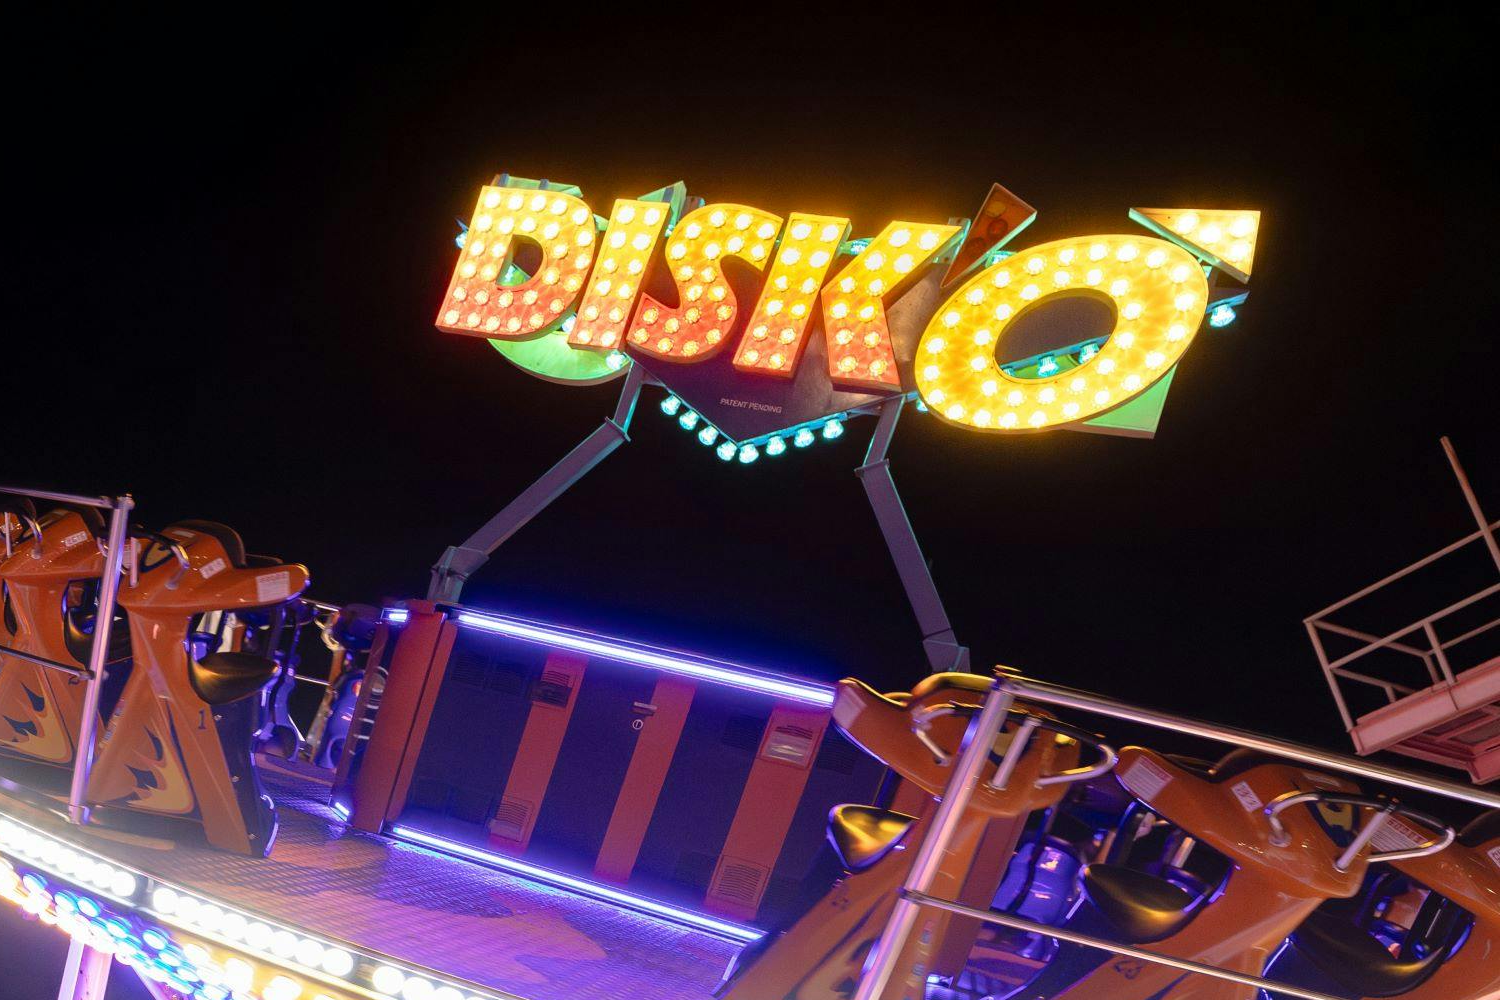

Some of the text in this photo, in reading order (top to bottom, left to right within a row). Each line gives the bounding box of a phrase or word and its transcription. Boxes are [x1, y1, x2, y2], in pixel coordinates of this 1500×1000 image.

[719, 398, 783, 414] PATENT PENDING
[197, 708, 207, 730] 1
